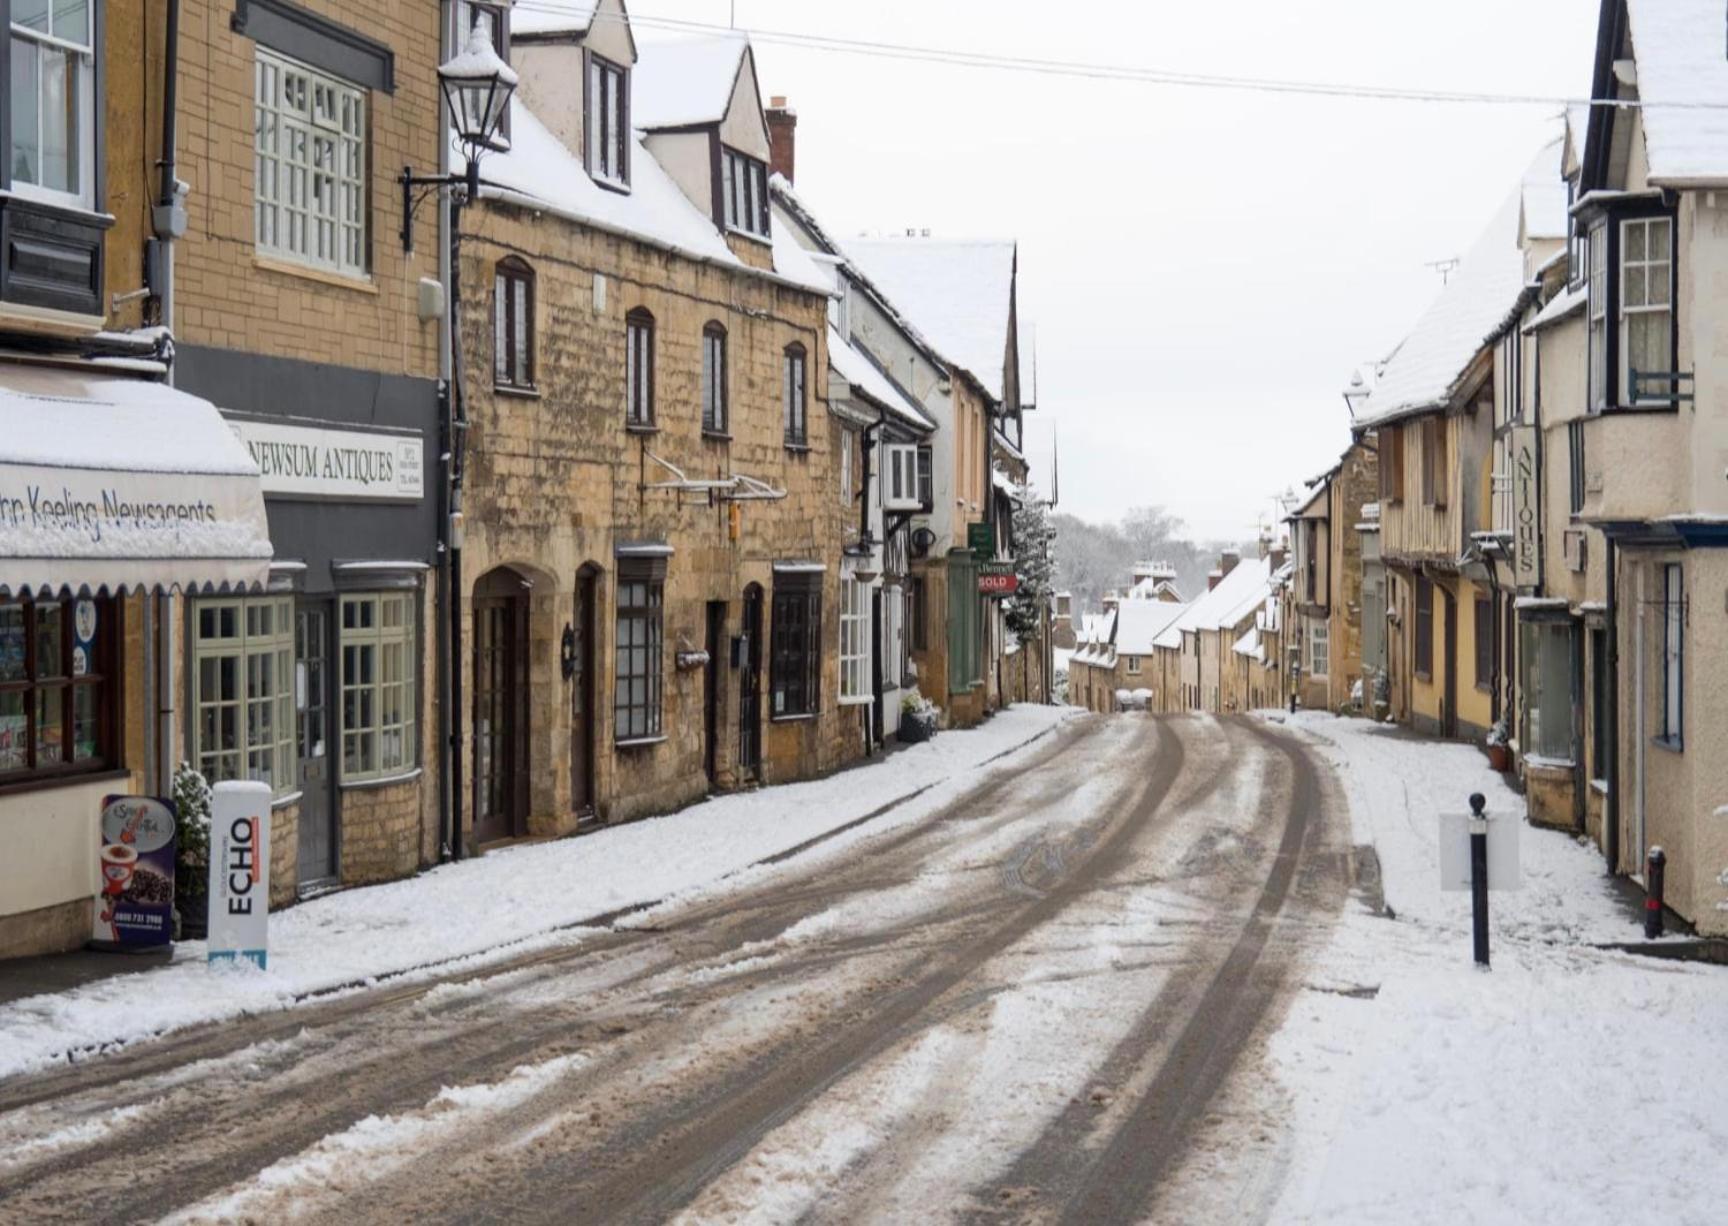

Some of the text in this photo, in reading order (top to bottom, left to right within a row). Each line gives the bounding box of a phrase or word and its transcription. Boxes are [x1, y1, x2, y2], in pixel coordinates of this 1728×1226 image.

[247, 440, 317, 478] NEWSUM
[322, 447, 393, 485] ANTIQUES
[27, 485, 101, 543] Keeling
[102, 488, 216, 543] Newsagents
[978, 576, 1007, 587] SOLD
[229, 817, 252, 915] ECHO
